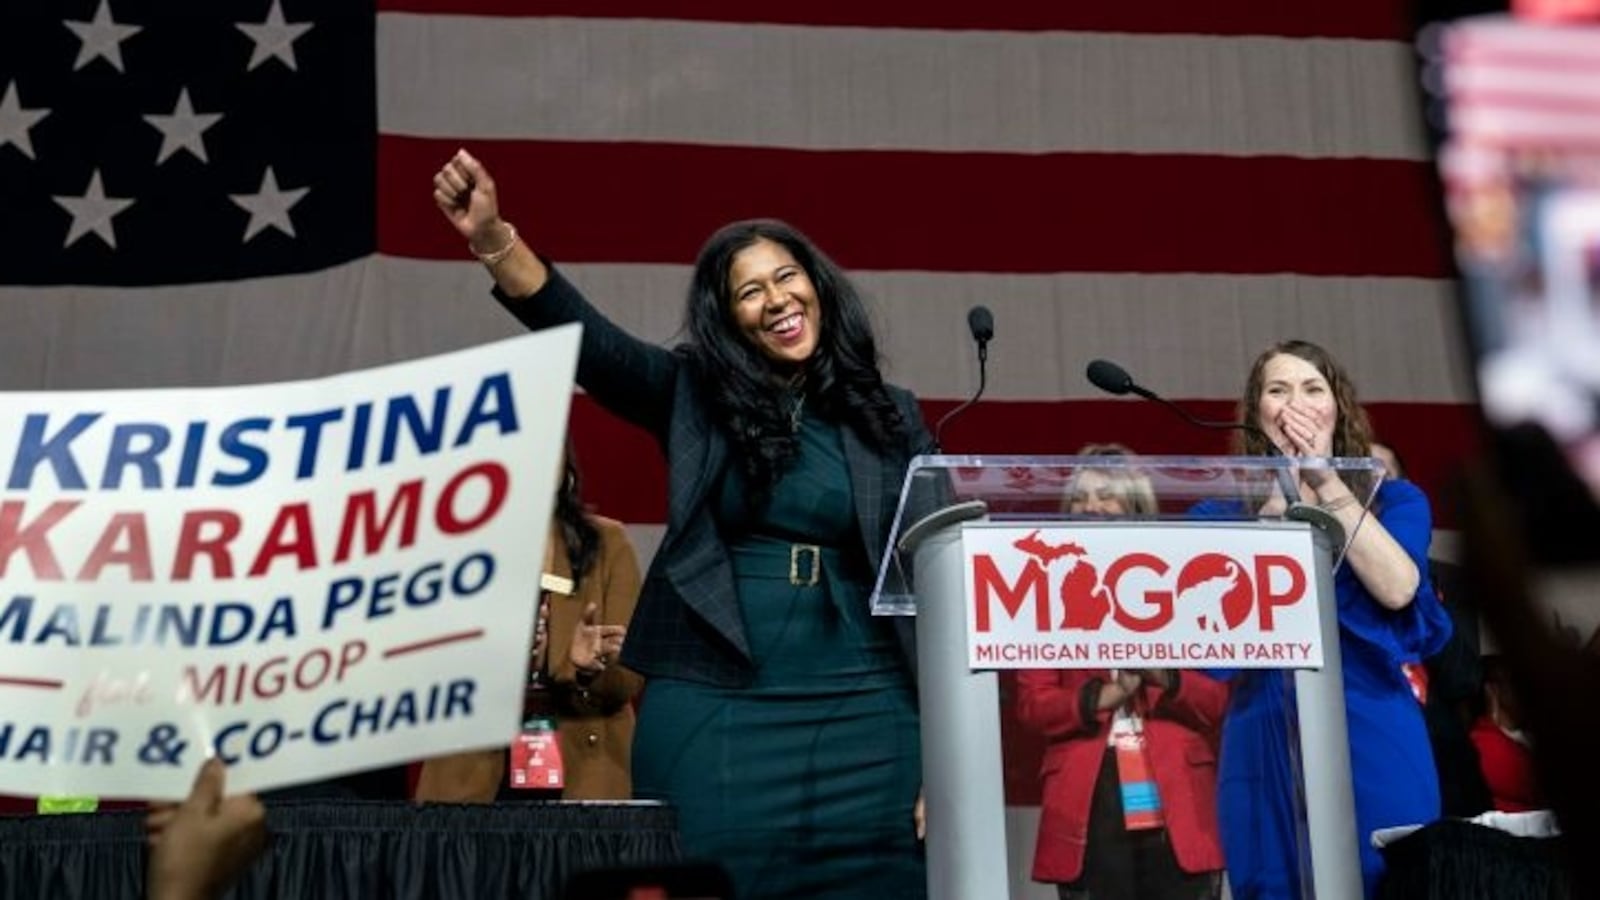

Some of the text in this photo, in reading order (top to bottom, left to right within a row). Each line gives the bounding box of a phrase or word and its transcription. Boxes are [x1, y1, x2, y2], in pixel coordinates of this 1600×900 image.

[6, 371, 521, 491] KRISTINA
[0, 460, 510, 583] KARAMO
[0, 550, 496, 648] MALINDA PEGO
[177, 638, 367, 706] MIGOP
[976, 643, 1313, 661] MICHIGAN REPUBLICAN PARTY
[137, 722, 188, 767] &
